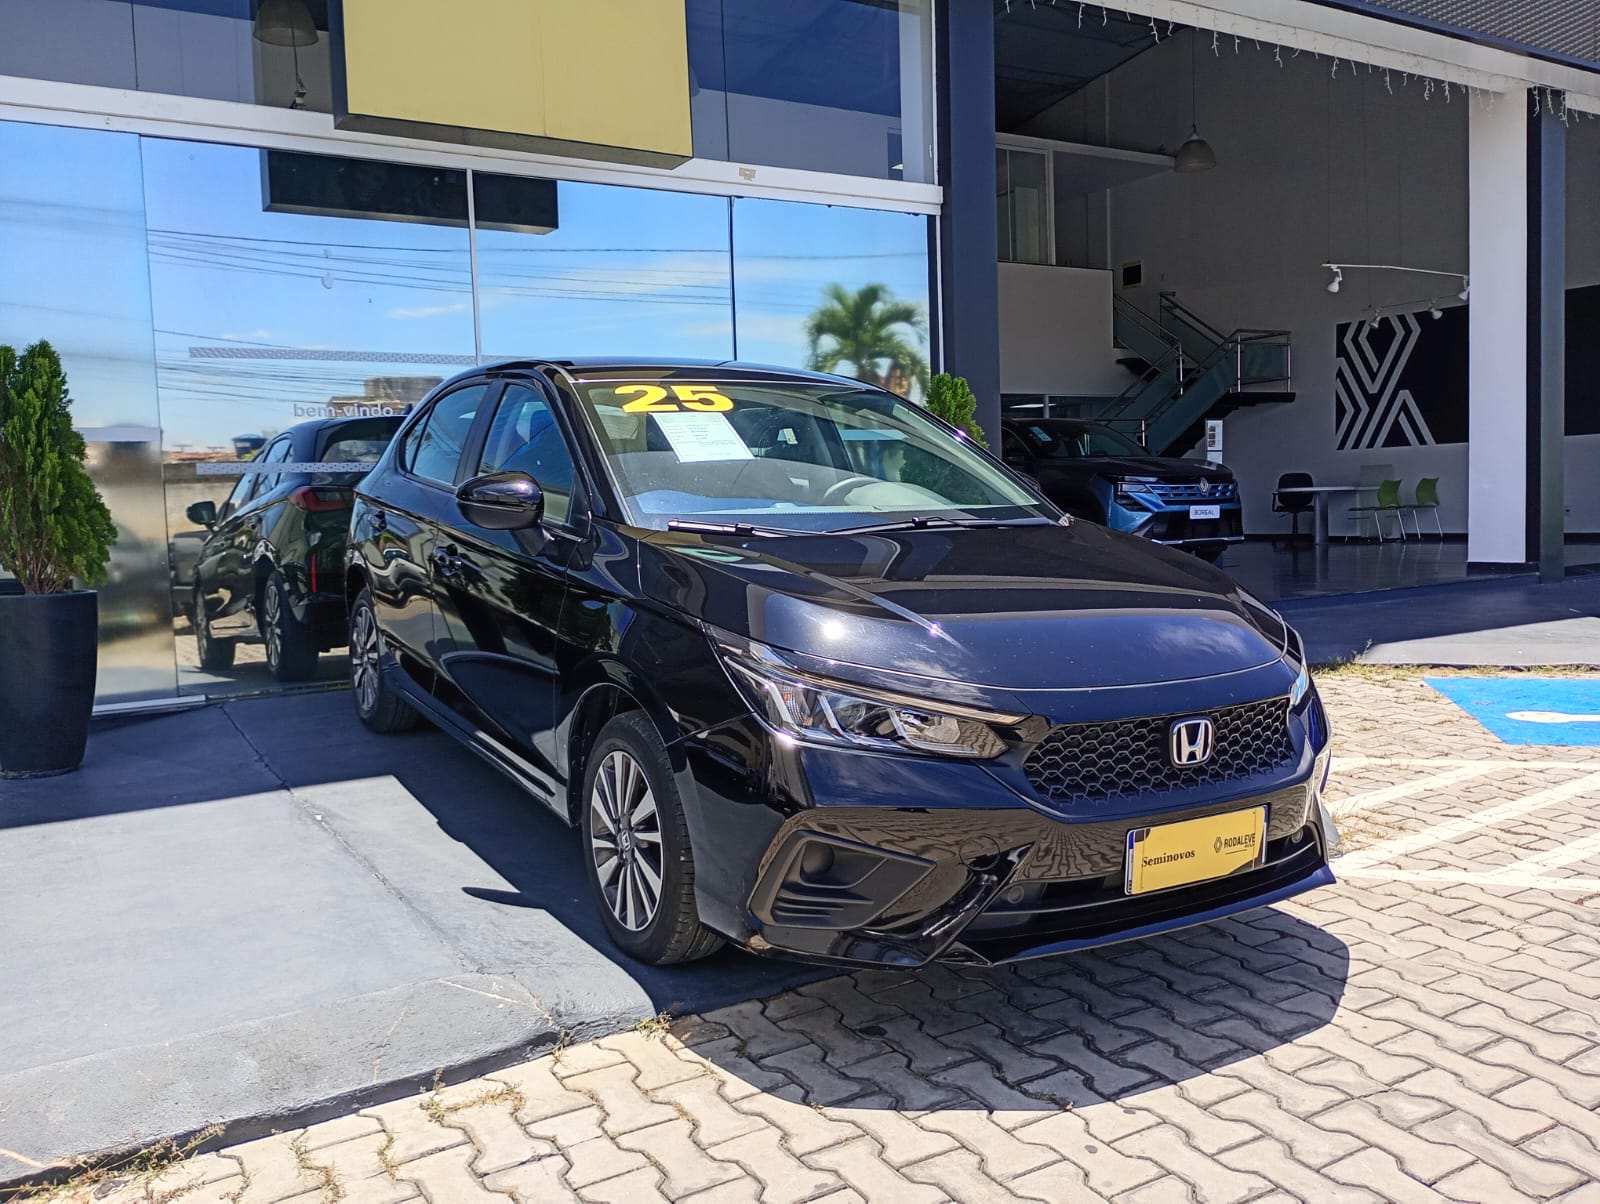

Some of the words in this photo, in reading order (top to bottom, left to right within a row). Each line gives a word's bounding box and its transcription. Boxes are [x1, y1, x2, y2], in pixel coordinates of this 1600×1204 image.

[614, 384, 735, 413] 25
[293, 403, 394, 417] bem-vindo
[1224, 833, 1255, 848] RODALEVE
[1142, 850, 1196, 868] Seminovos
